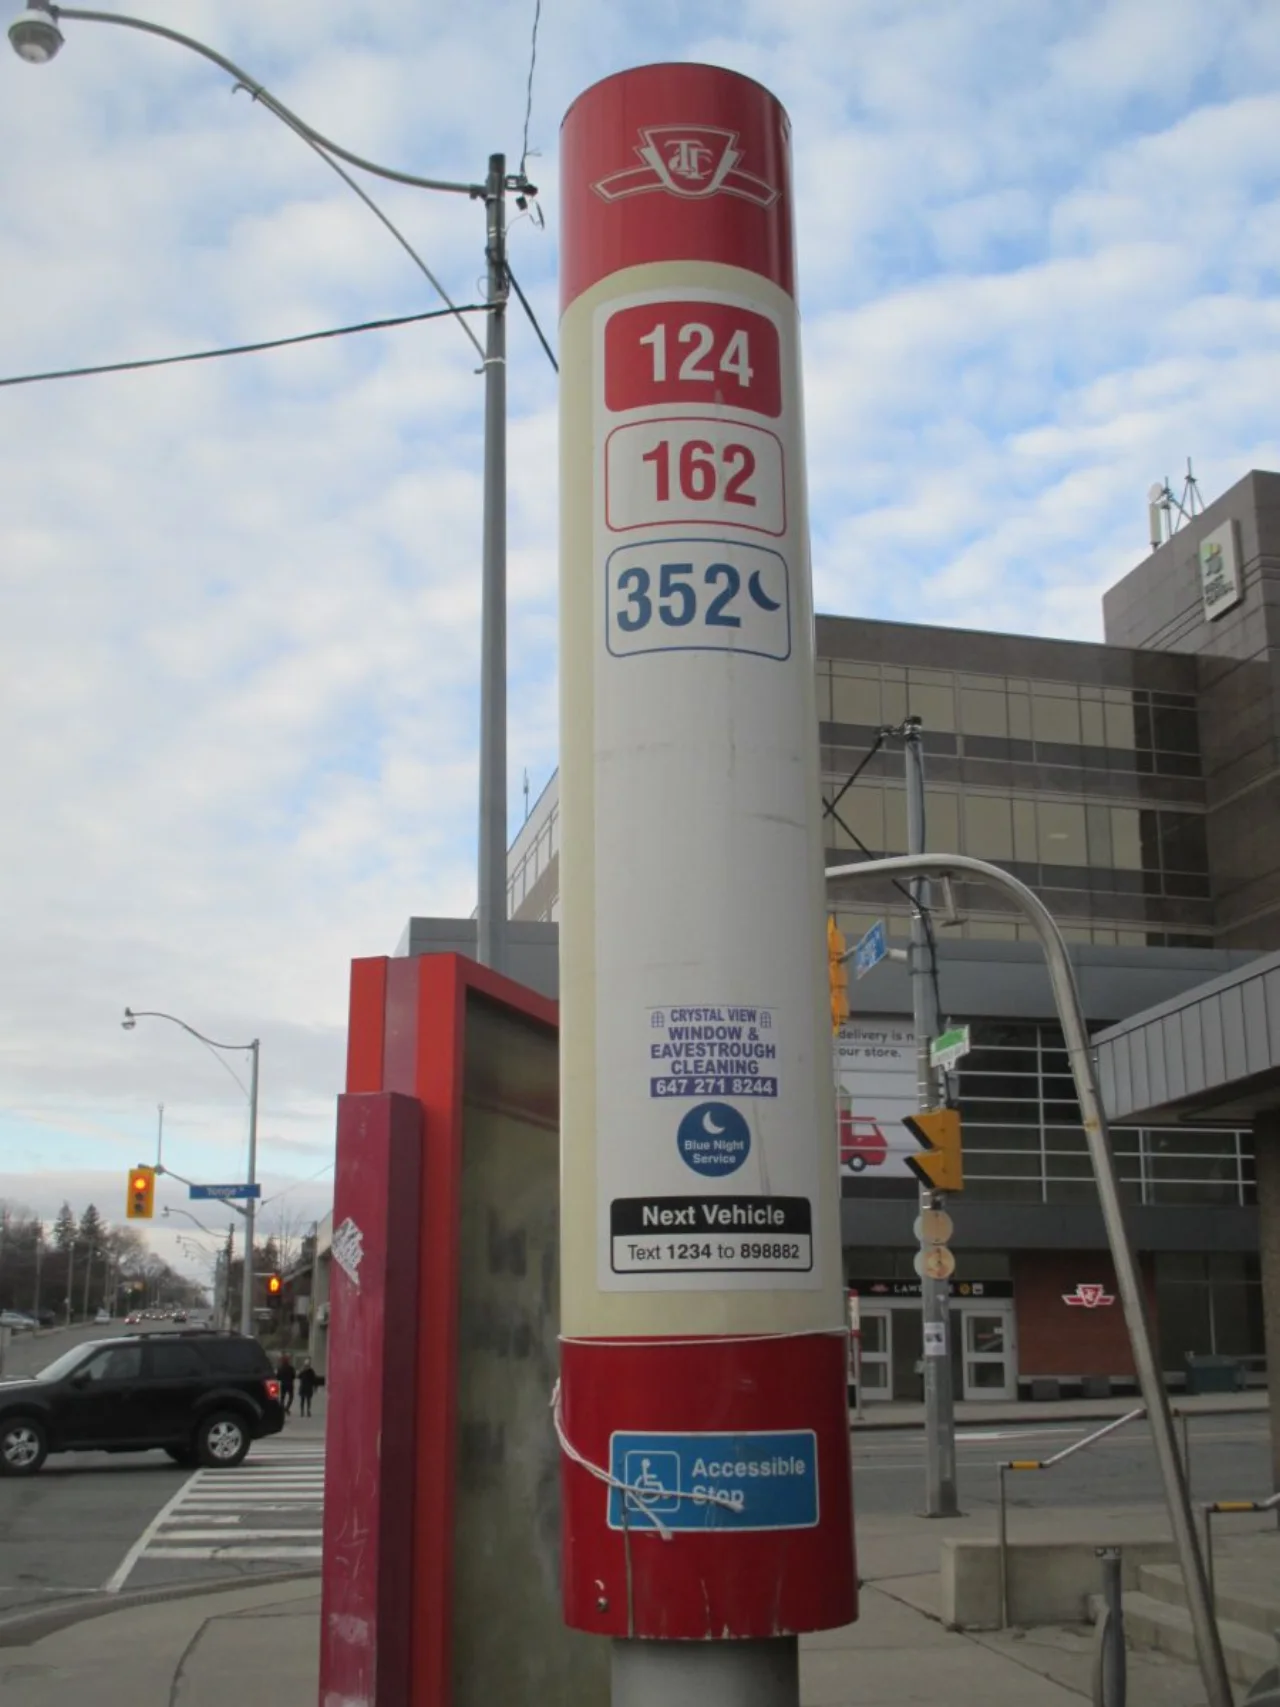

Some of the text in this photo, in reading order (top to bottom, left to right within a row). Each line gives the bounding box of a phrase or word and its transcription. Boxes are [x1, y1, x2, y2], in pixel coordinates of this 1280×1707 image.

[639, 322, 754, 388] 124
[642, 439, 757, 508] 162
[616, 562, 742, 633] 352
[671, 1008, 757, 1022] CRYSTAL VIEW
[668, 1026, 759, 1041] WINDOW &
[838, 1029, 888, 1044] delivery
[651, 1042, 776, 1059] EAVESTROUGH
[839, 1047, 861, 1057] our
[671, 1059, 759, 1075] CLEANING
[656, 1078, 773, 1095] 647 271 8244
[684, 1139, 744, 1152] Blue Night
[693, 1152, 736, 1164] Service
[642, 1203, 786, 1226] Next Vehicle
[627, 1243, 800, 1261] Text 1234 to 898882
[691, 1456, 806, 1478] Accessible
[691, 1484, 745, 1506] Stop
